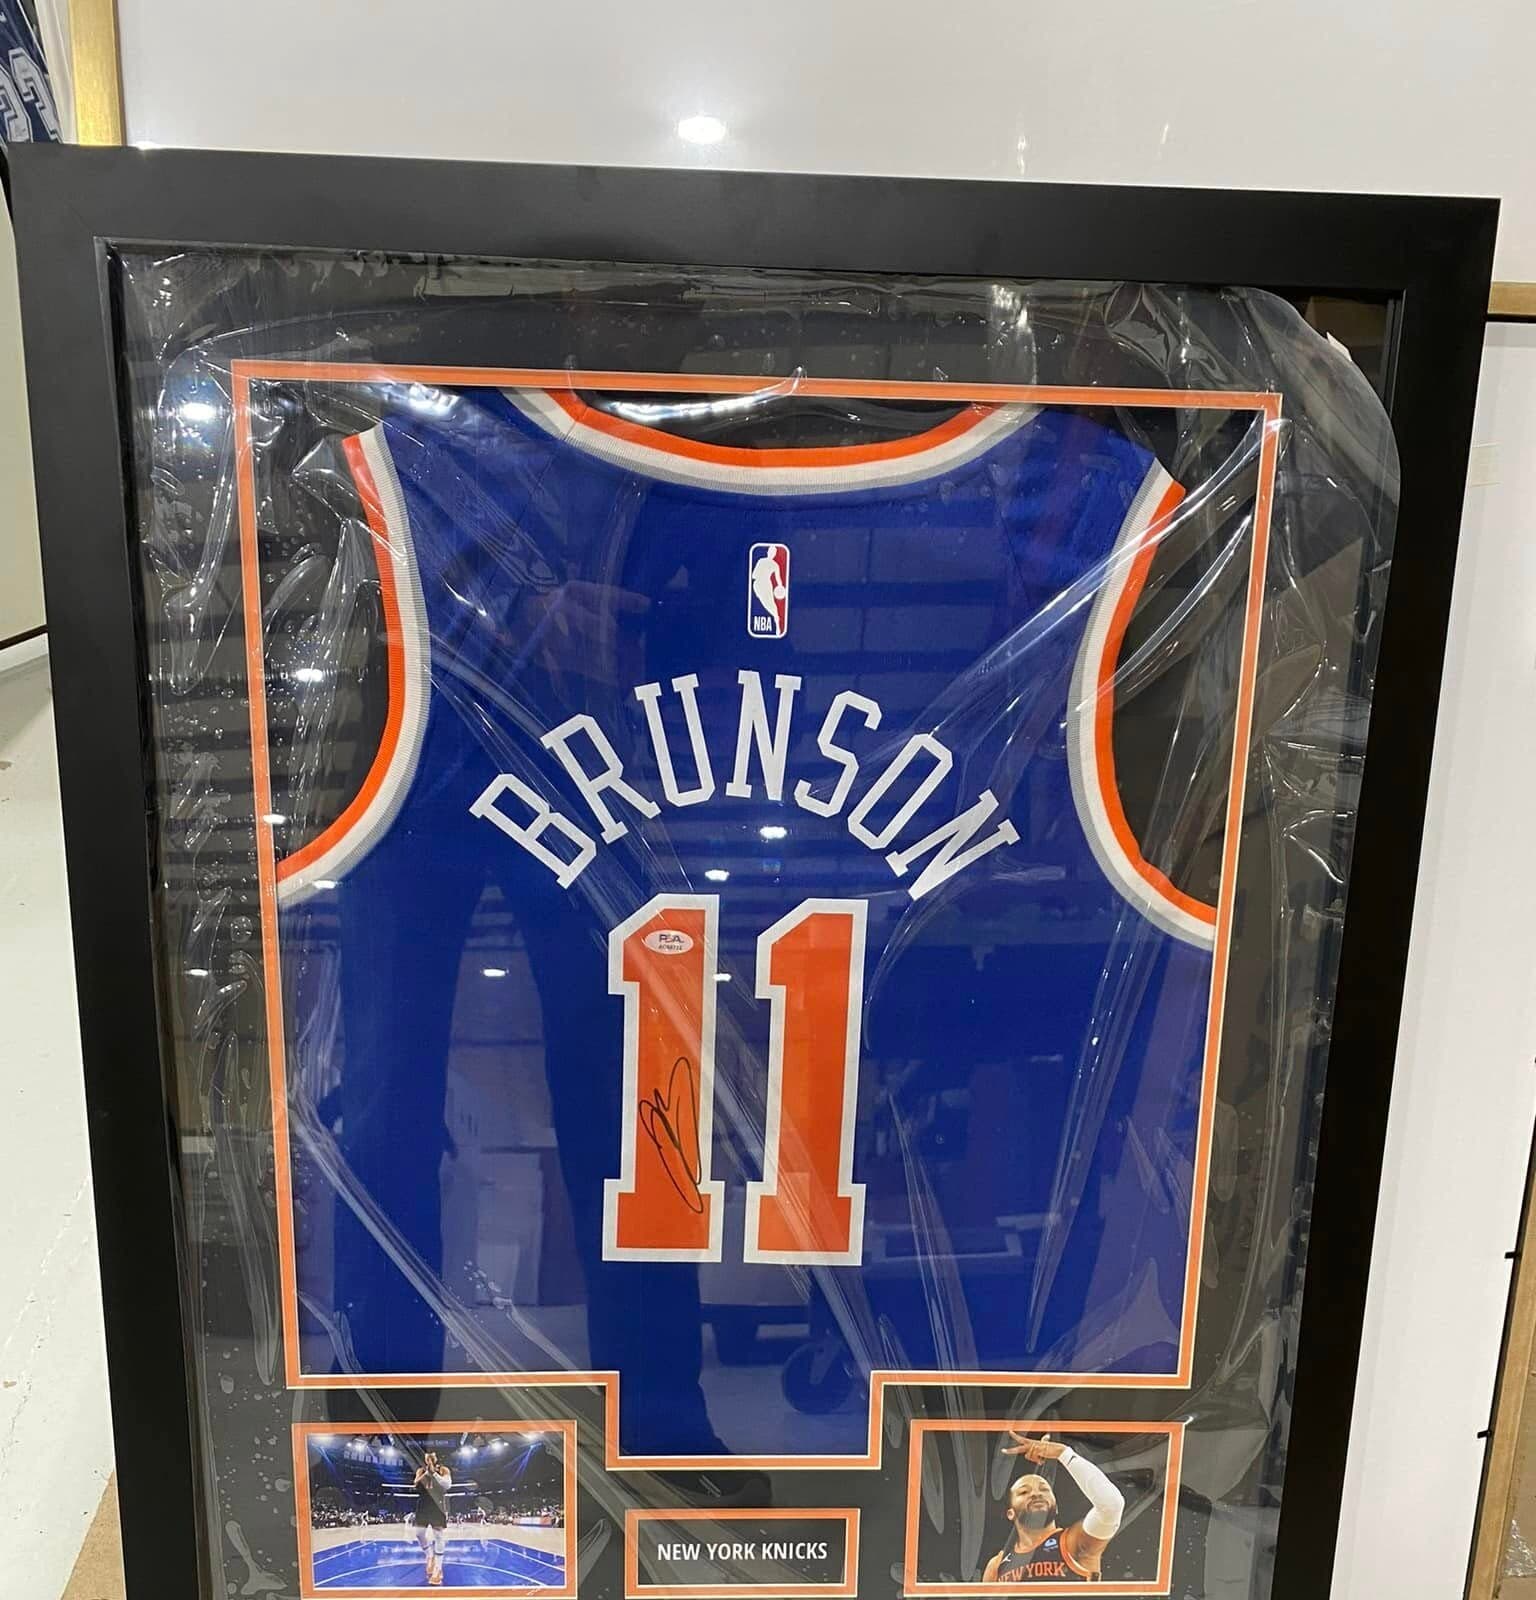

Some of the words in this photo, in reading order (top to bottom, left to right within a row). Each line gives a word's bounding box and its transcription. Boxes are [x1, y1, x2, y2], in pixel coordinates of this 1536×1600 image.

[754, 616, 772, 632] NBA
[469, 670, 1020, 900] BRUNSON
[602, 893, 869, 1266] 11
[657, 1543, 700, 1560] NEW
[707, 1543, 755, 1560] YORK
[762, 1542, 828, 1560] KNICKS
[1026, 1561, 1066, 1578] YORK
